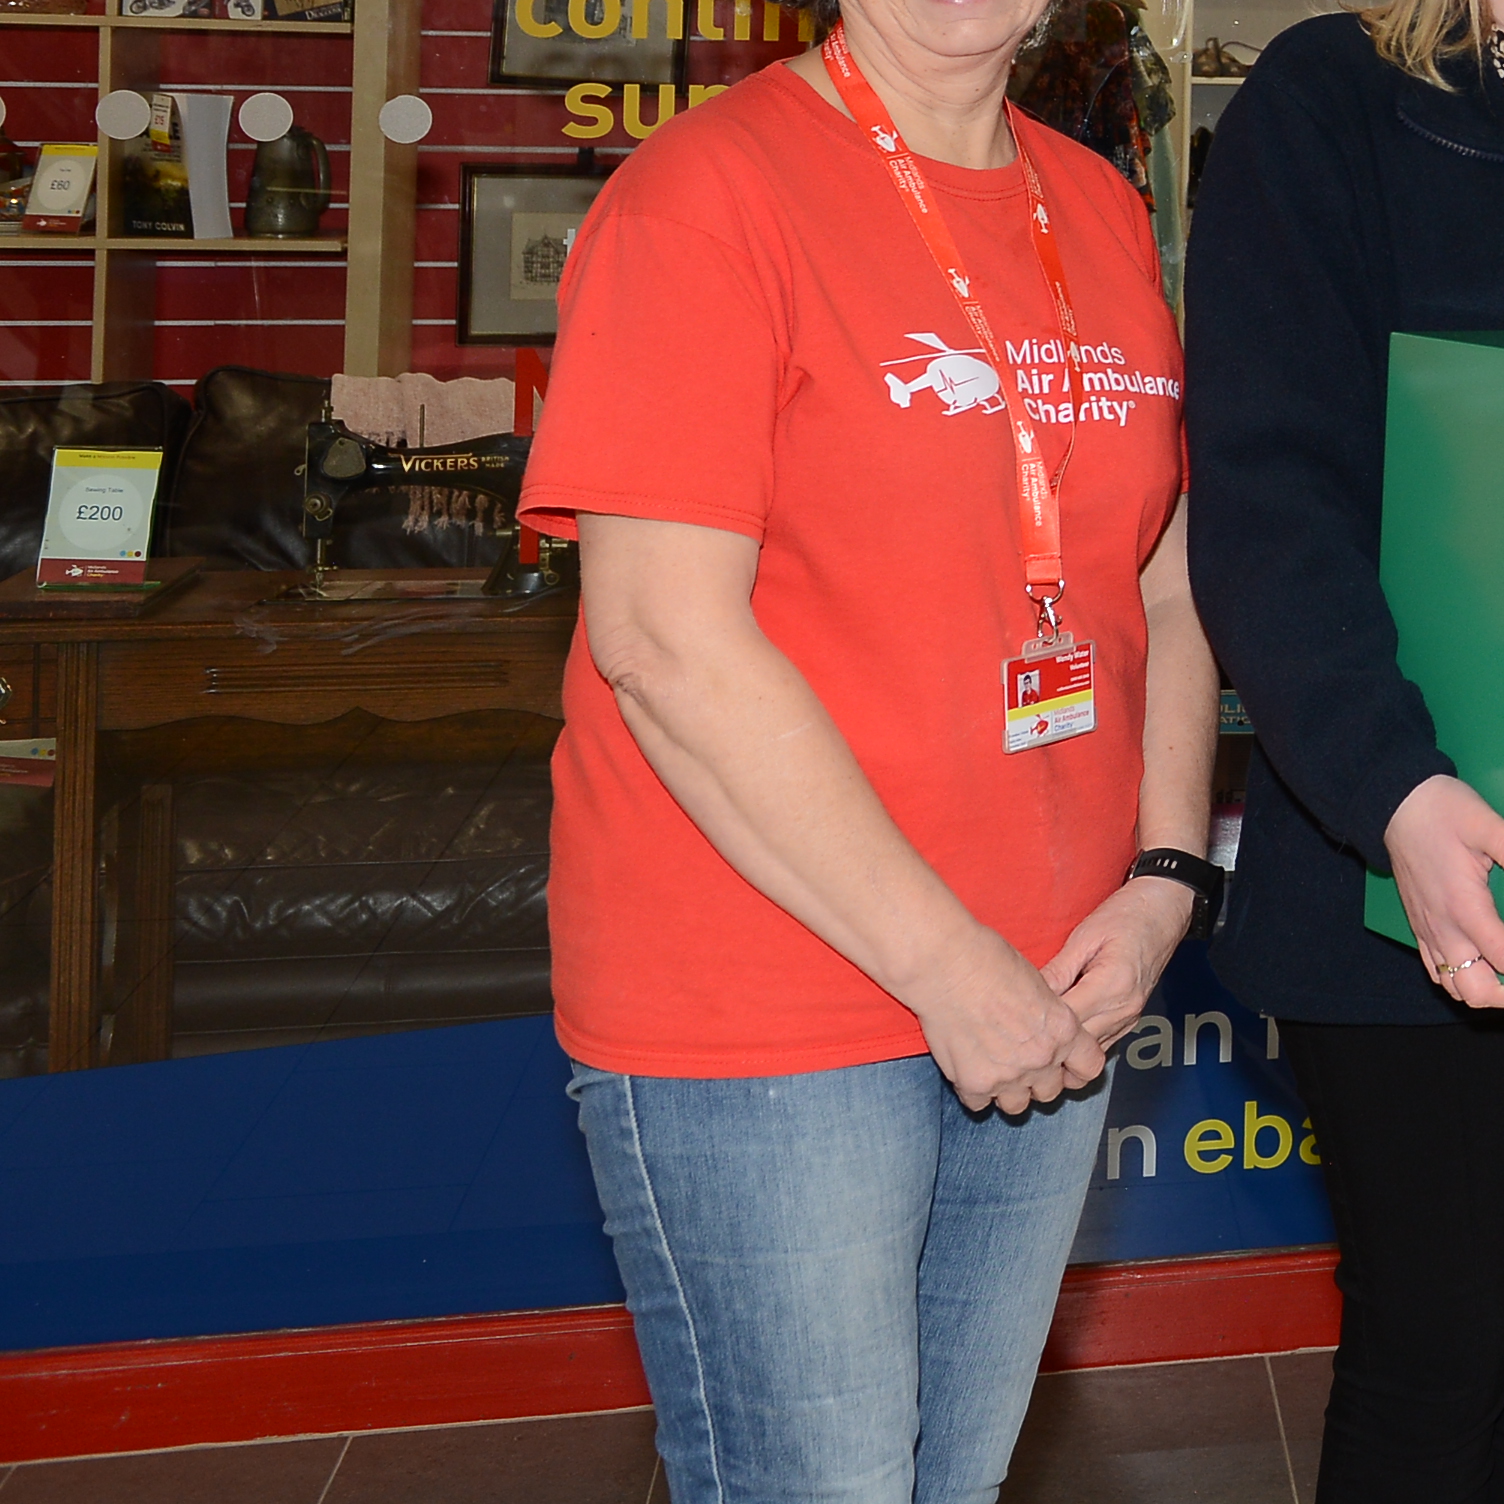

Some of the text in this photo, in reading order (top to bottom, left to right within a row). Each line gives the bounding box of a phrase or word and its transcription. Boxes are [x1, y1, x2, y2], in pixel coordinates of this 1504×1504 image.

[903, 155, 925, 190] Midlands
[902, 169, 929, 214] Ambulance
[1005, 339, 1126, 366] Midlnds
[1016, 368, 1054, 395] Air
[400, 453, 479, 473] VICKERS
[76, 504, 124, 521] £200
